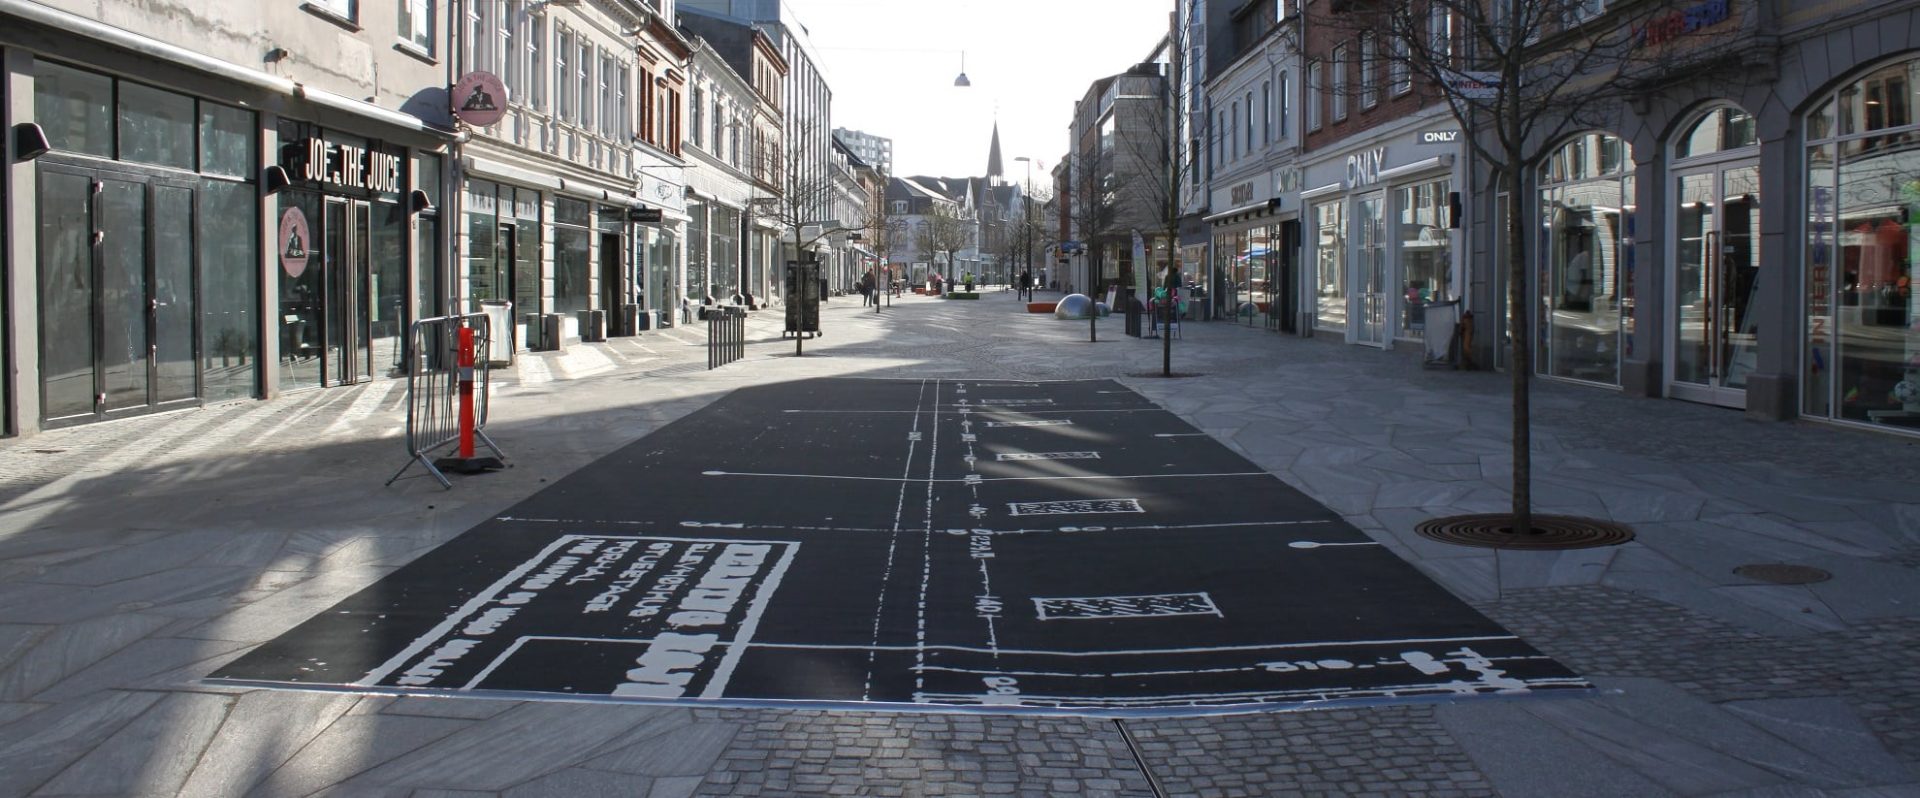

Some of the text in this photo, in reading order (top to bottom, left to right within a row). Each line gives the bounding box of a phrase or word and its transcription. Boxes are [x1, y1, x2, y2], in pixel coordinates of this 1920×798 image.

[1424, 131, 1458, 143] ONLY
[305, 137, 400, 194] JOE & THE JUICE
[1347, 146, 1386, 189] ONLY
[566, 540, 638, 585] FORHAL
